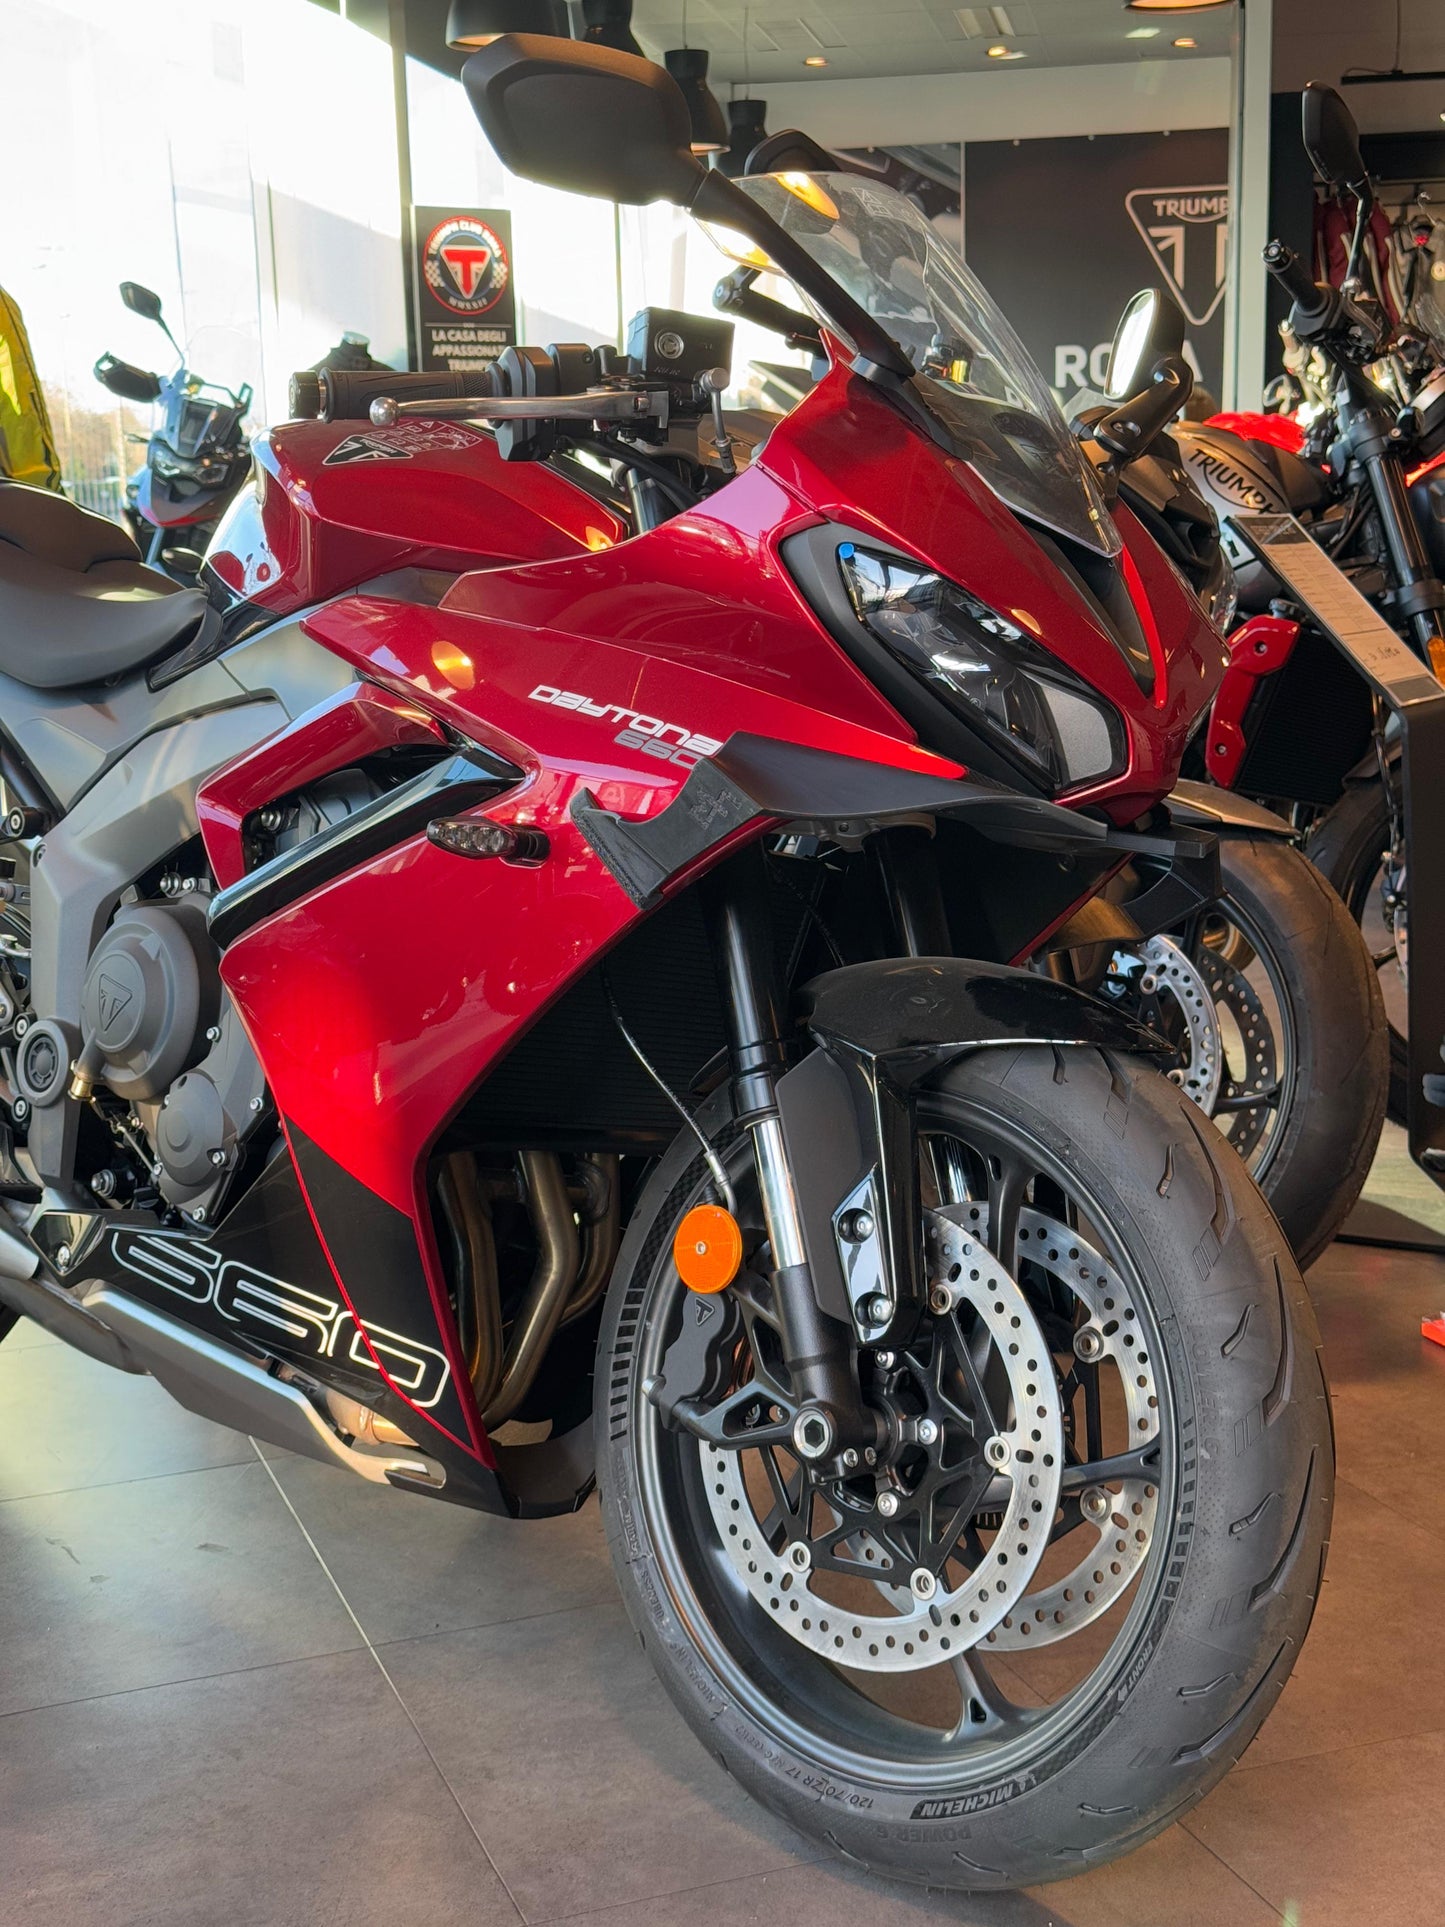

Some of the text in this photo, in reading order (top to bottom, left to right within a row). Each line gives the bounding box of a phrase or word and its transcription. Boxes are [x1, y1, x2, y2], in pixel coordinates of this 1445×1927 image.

[1153, 195, 1228, 222] TRIUMP
[432, 329, 447, 341] LA
[447, 329, 476, 341] CASA
[1055, 340, 1203, 388] ROA
[920, 1783, 1014, 1817] MICHELIN
